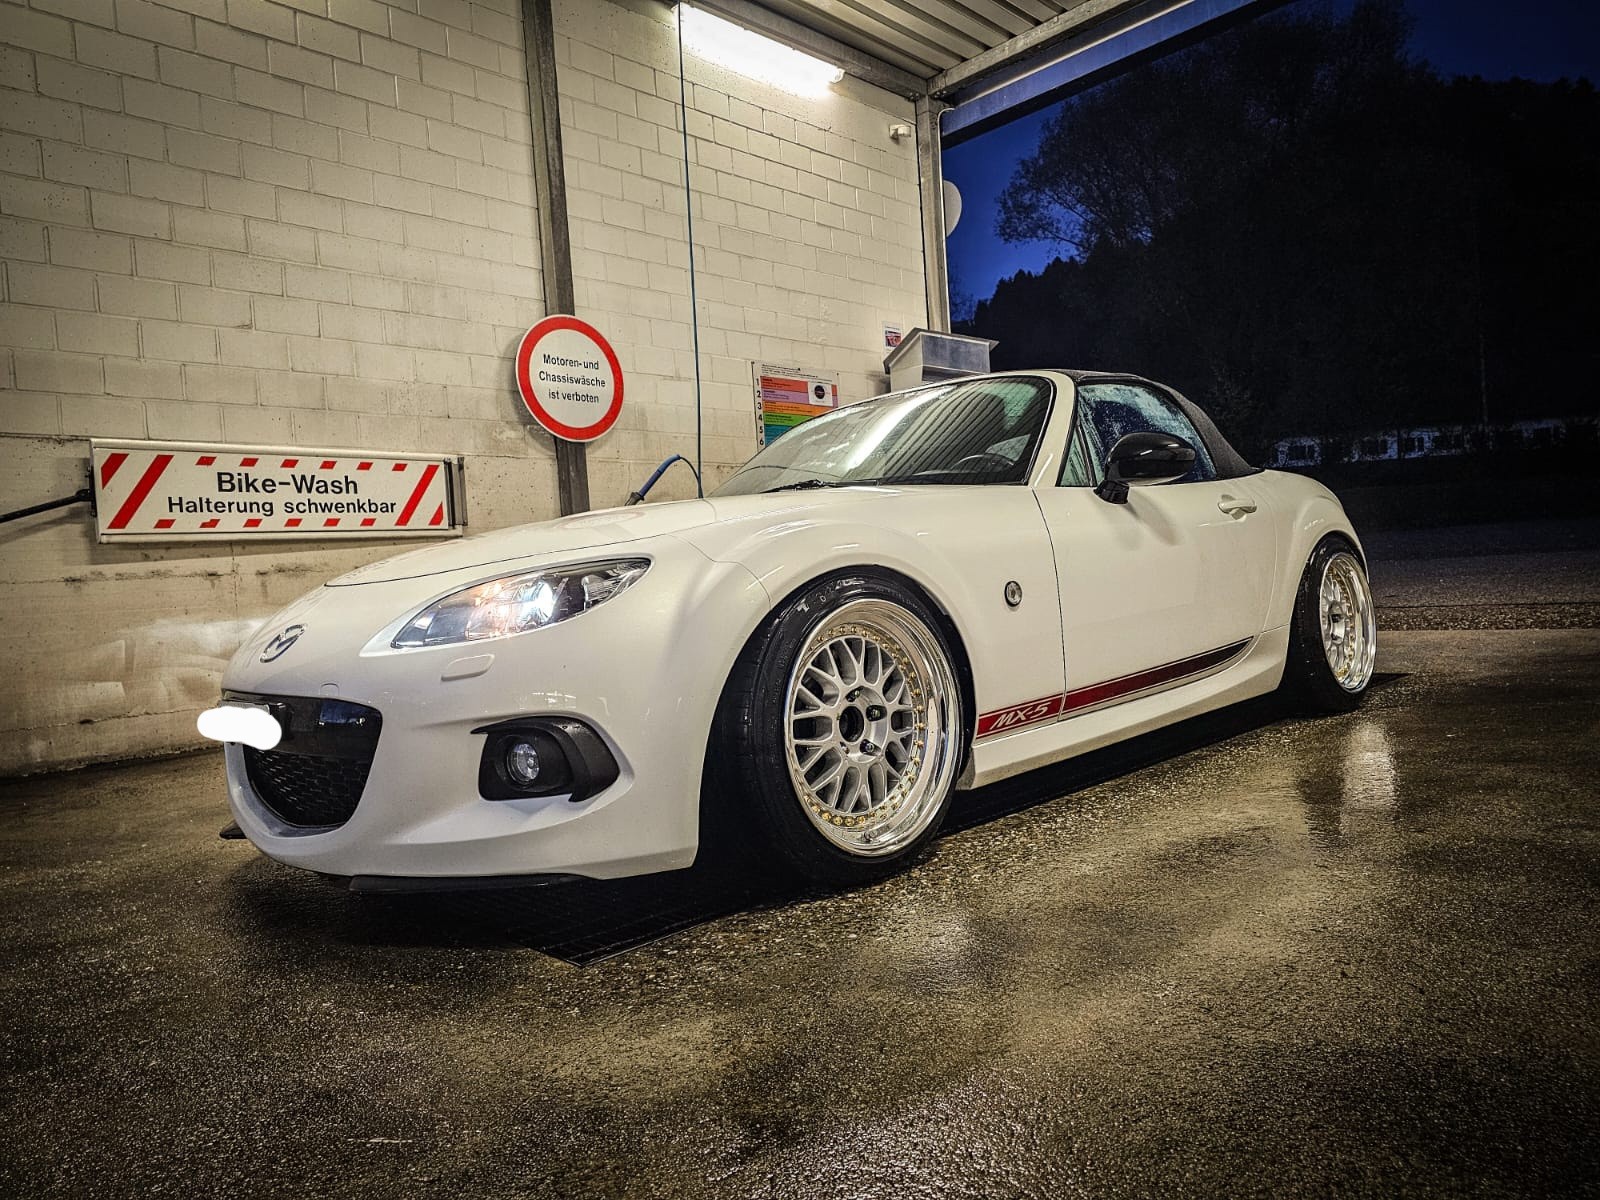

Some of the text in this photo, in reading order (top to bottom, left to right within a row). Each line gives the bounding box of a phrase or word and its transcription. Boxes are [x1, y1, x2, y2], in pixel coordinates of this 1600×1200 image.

[539, 370, 606, 387] Chassiswäsche
[548, 389, 600, 403] ist verboten
[756, 390, 761, 398] 2
[757, 402, 762, 410] 3
[759, 426, 764, 434] 5
[216, 471, 359, 495] Bike-Wash
[167, 496, 397, 517] Halterung schwenkbar
[988, 701, 1052, 731] MX-5
